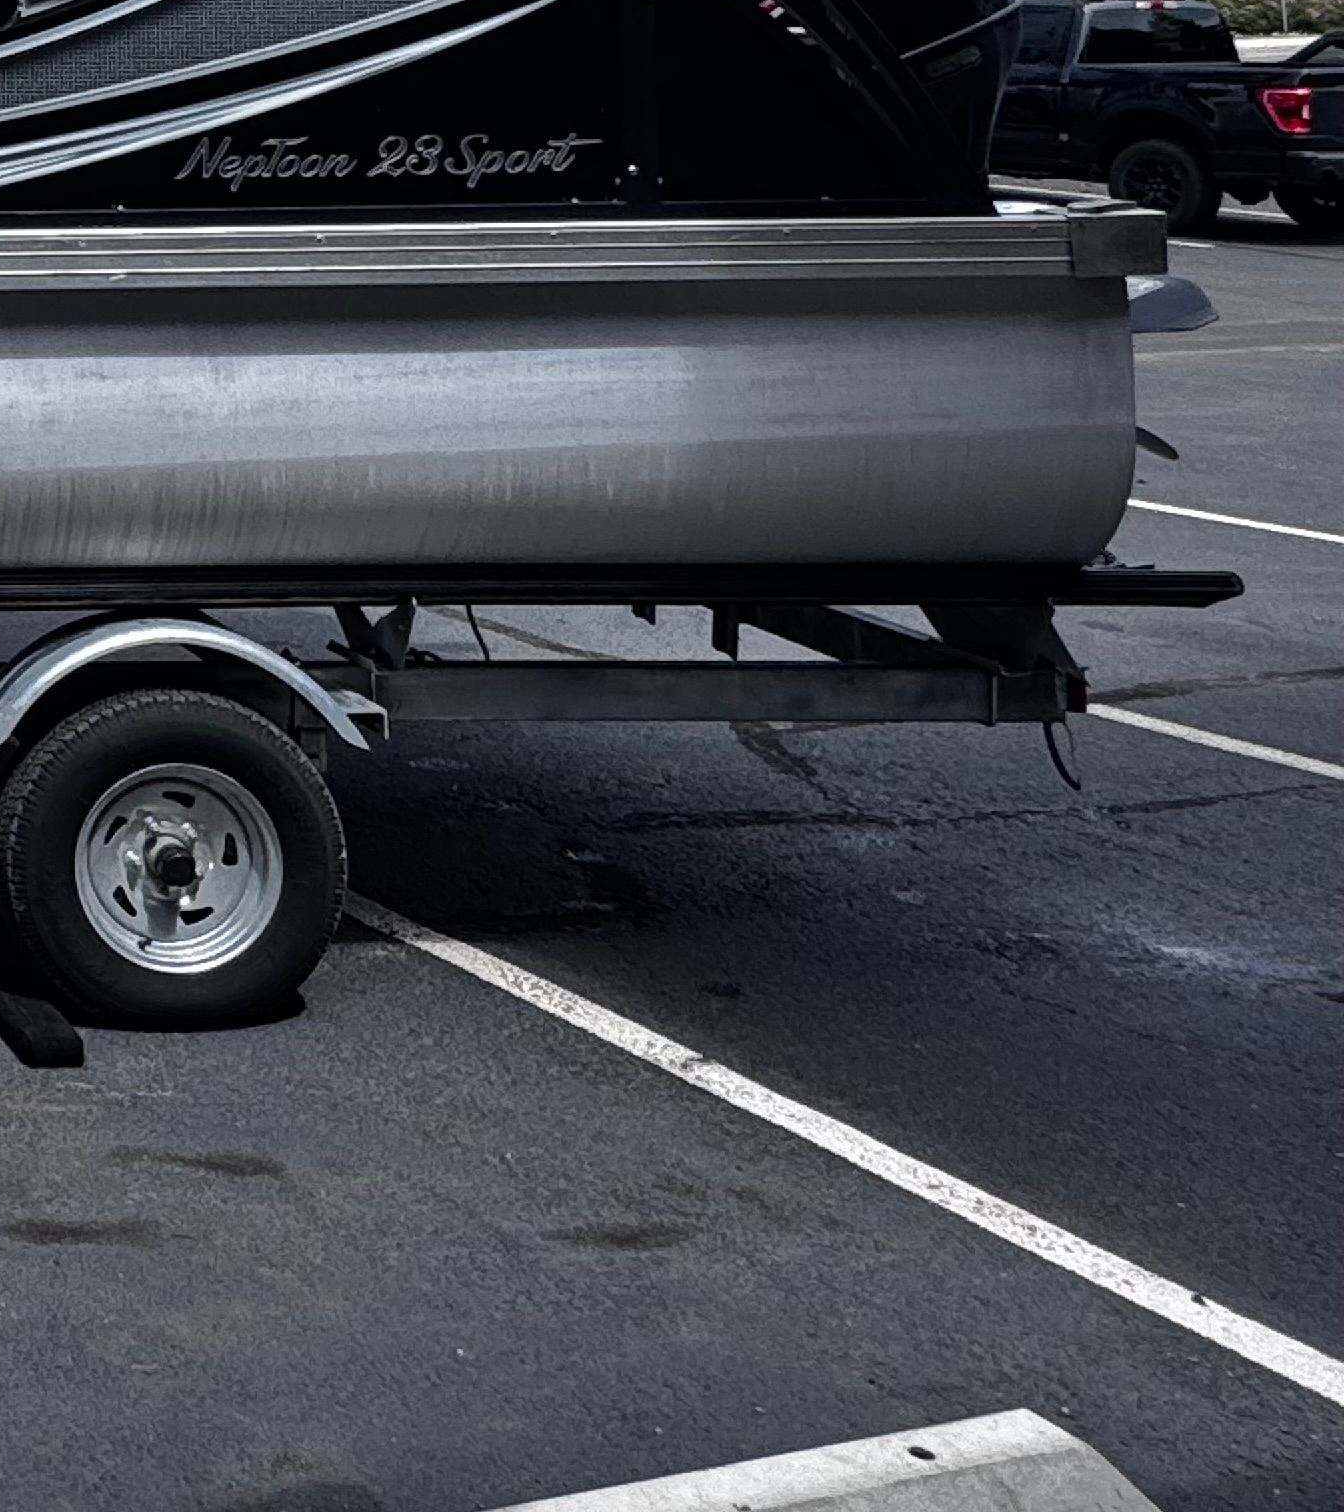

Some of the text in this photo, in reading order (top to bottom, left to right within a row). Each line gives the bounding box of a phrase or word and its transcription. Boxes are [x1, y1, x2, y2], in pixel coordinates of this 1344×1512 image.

[174, 133, 603, 192] NepToon 23 Sport
